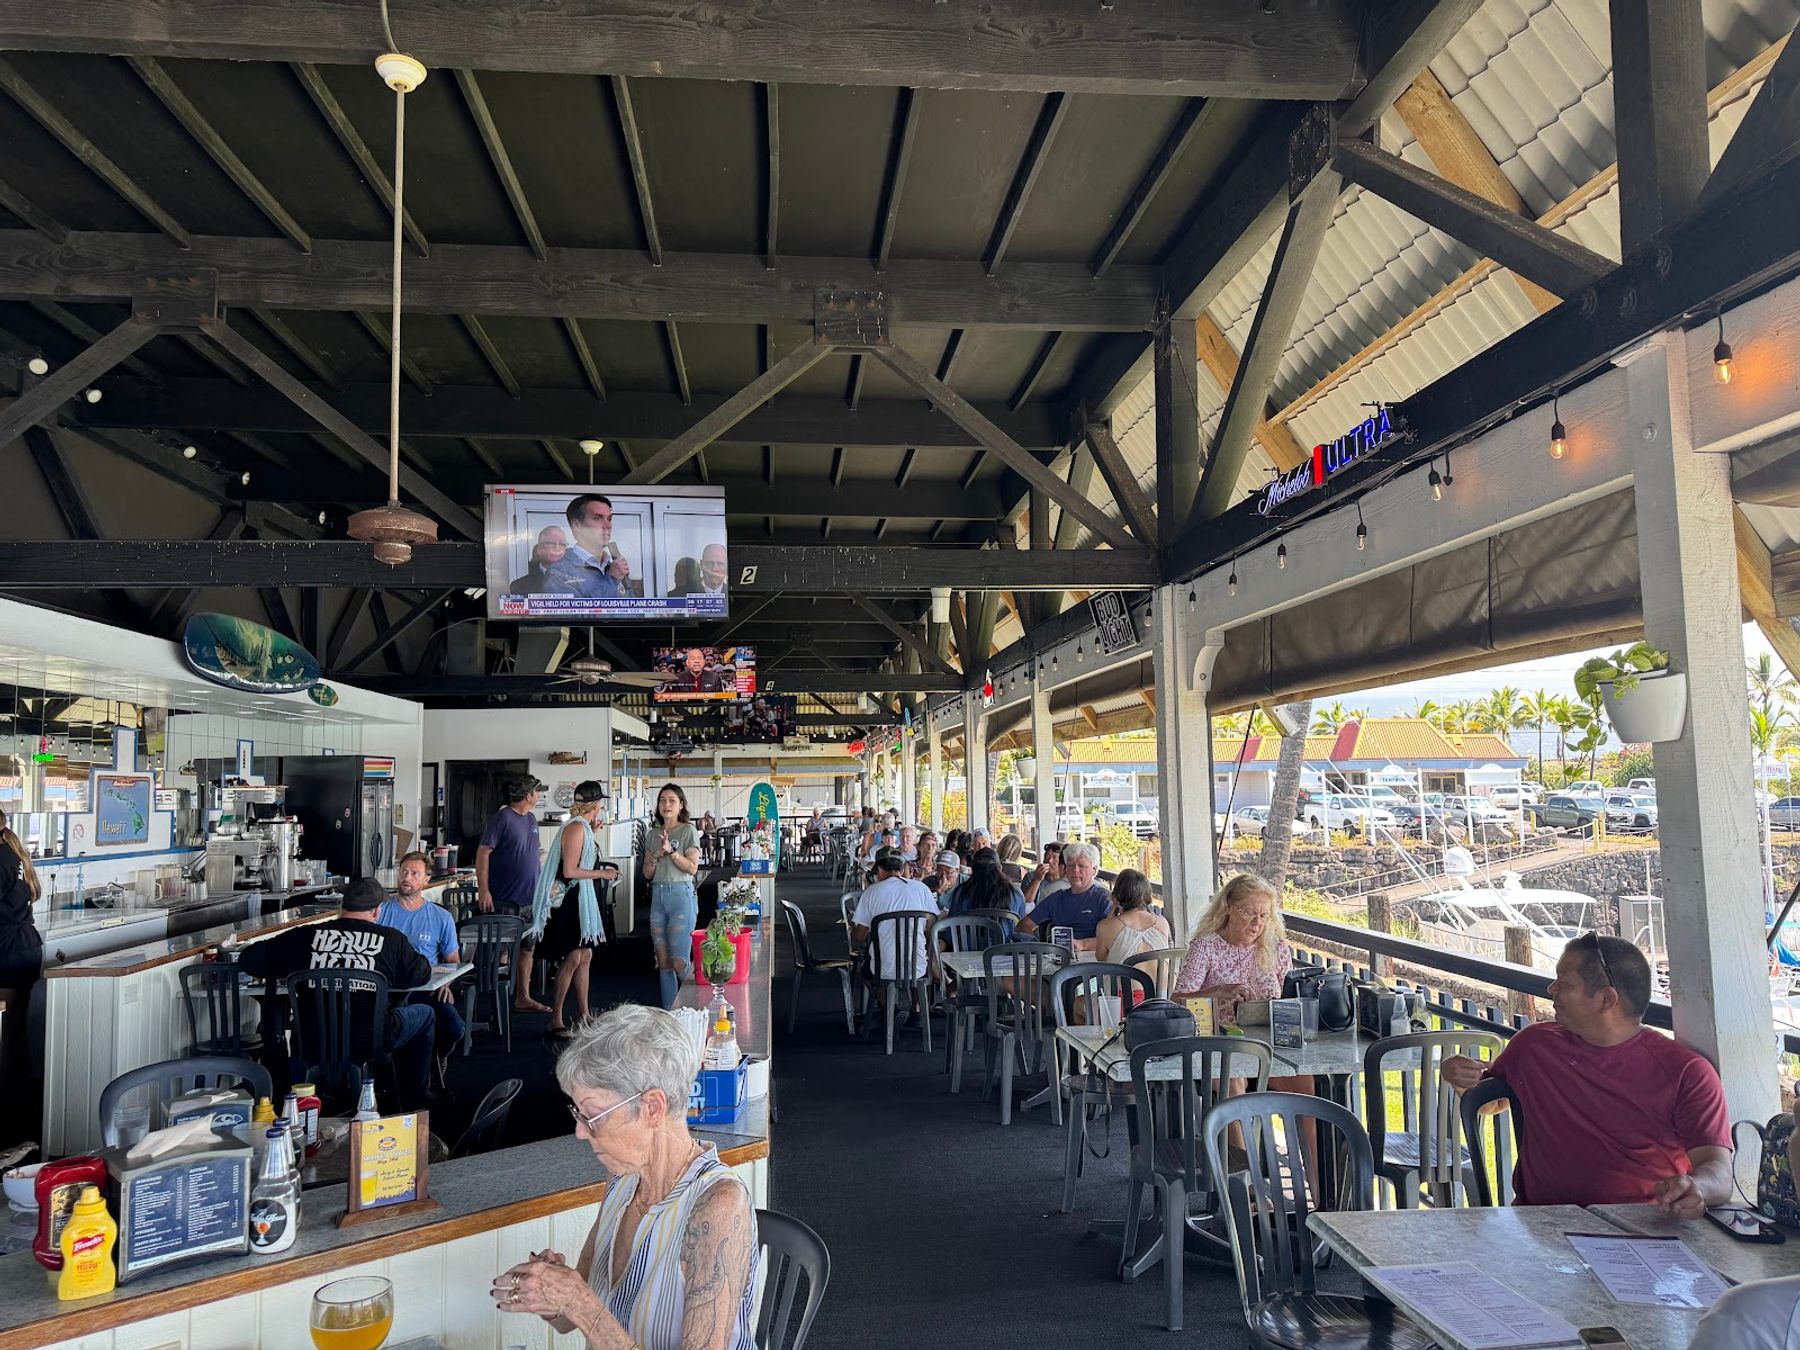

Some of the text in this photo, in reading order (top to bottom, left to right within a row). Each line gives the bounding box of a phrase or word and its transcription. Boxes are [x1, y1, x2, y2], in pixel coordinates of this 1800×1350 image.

[1257, 408, 1393, 515] Michelob ULTRA
[742, 567, 754, 583] 2
[503, 602, 525, 610] NOW
[545, 600, 559, 608] HELD
[560, 600, 571, 608] FOR
[1095, 592, 1120, 624] BUD
[1100, 615, 1132, 650] LIGHT
[311, 929, 384, 956] HEAVY
